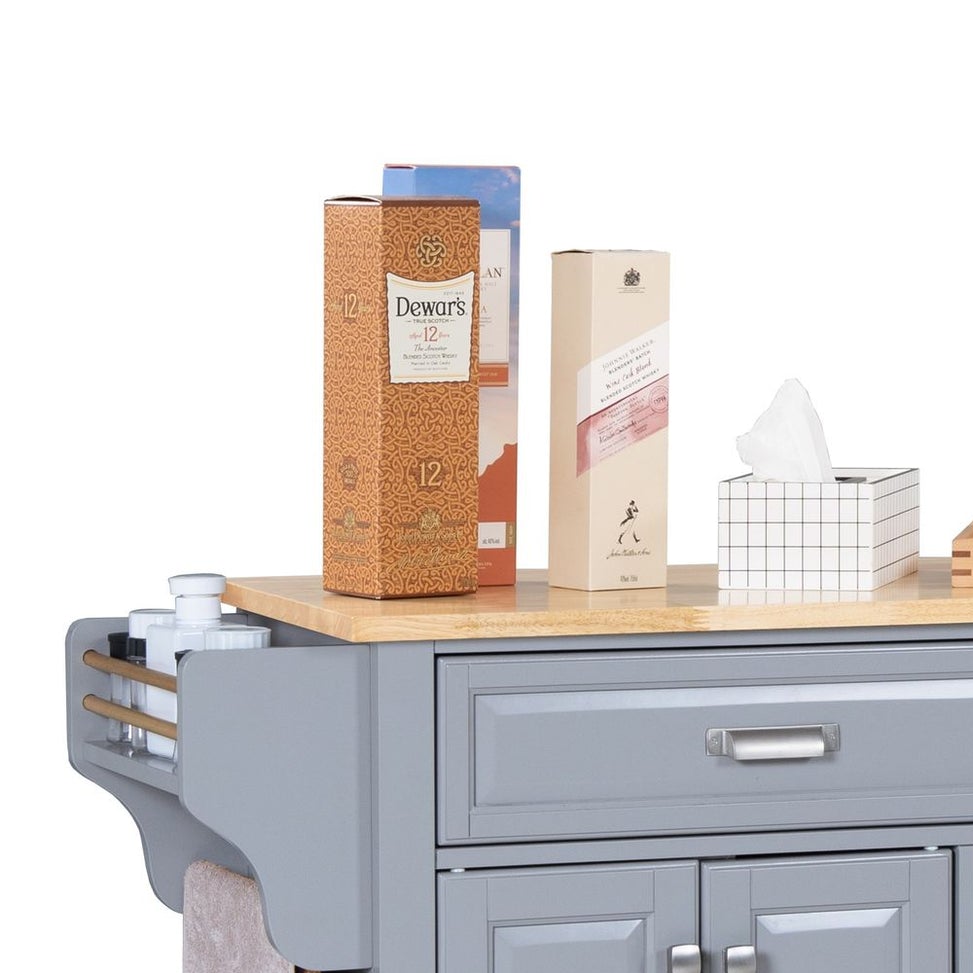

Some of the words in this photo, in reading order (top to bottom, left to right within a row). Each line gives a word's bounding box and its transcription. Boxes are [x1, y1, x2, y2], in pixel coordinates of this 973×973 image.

[344, 293, 357, 318] 12
[396, 296, 467, 317] Dewar's
[424, 326, 438, 342] 12
[419, 461, 442, 487] 12
